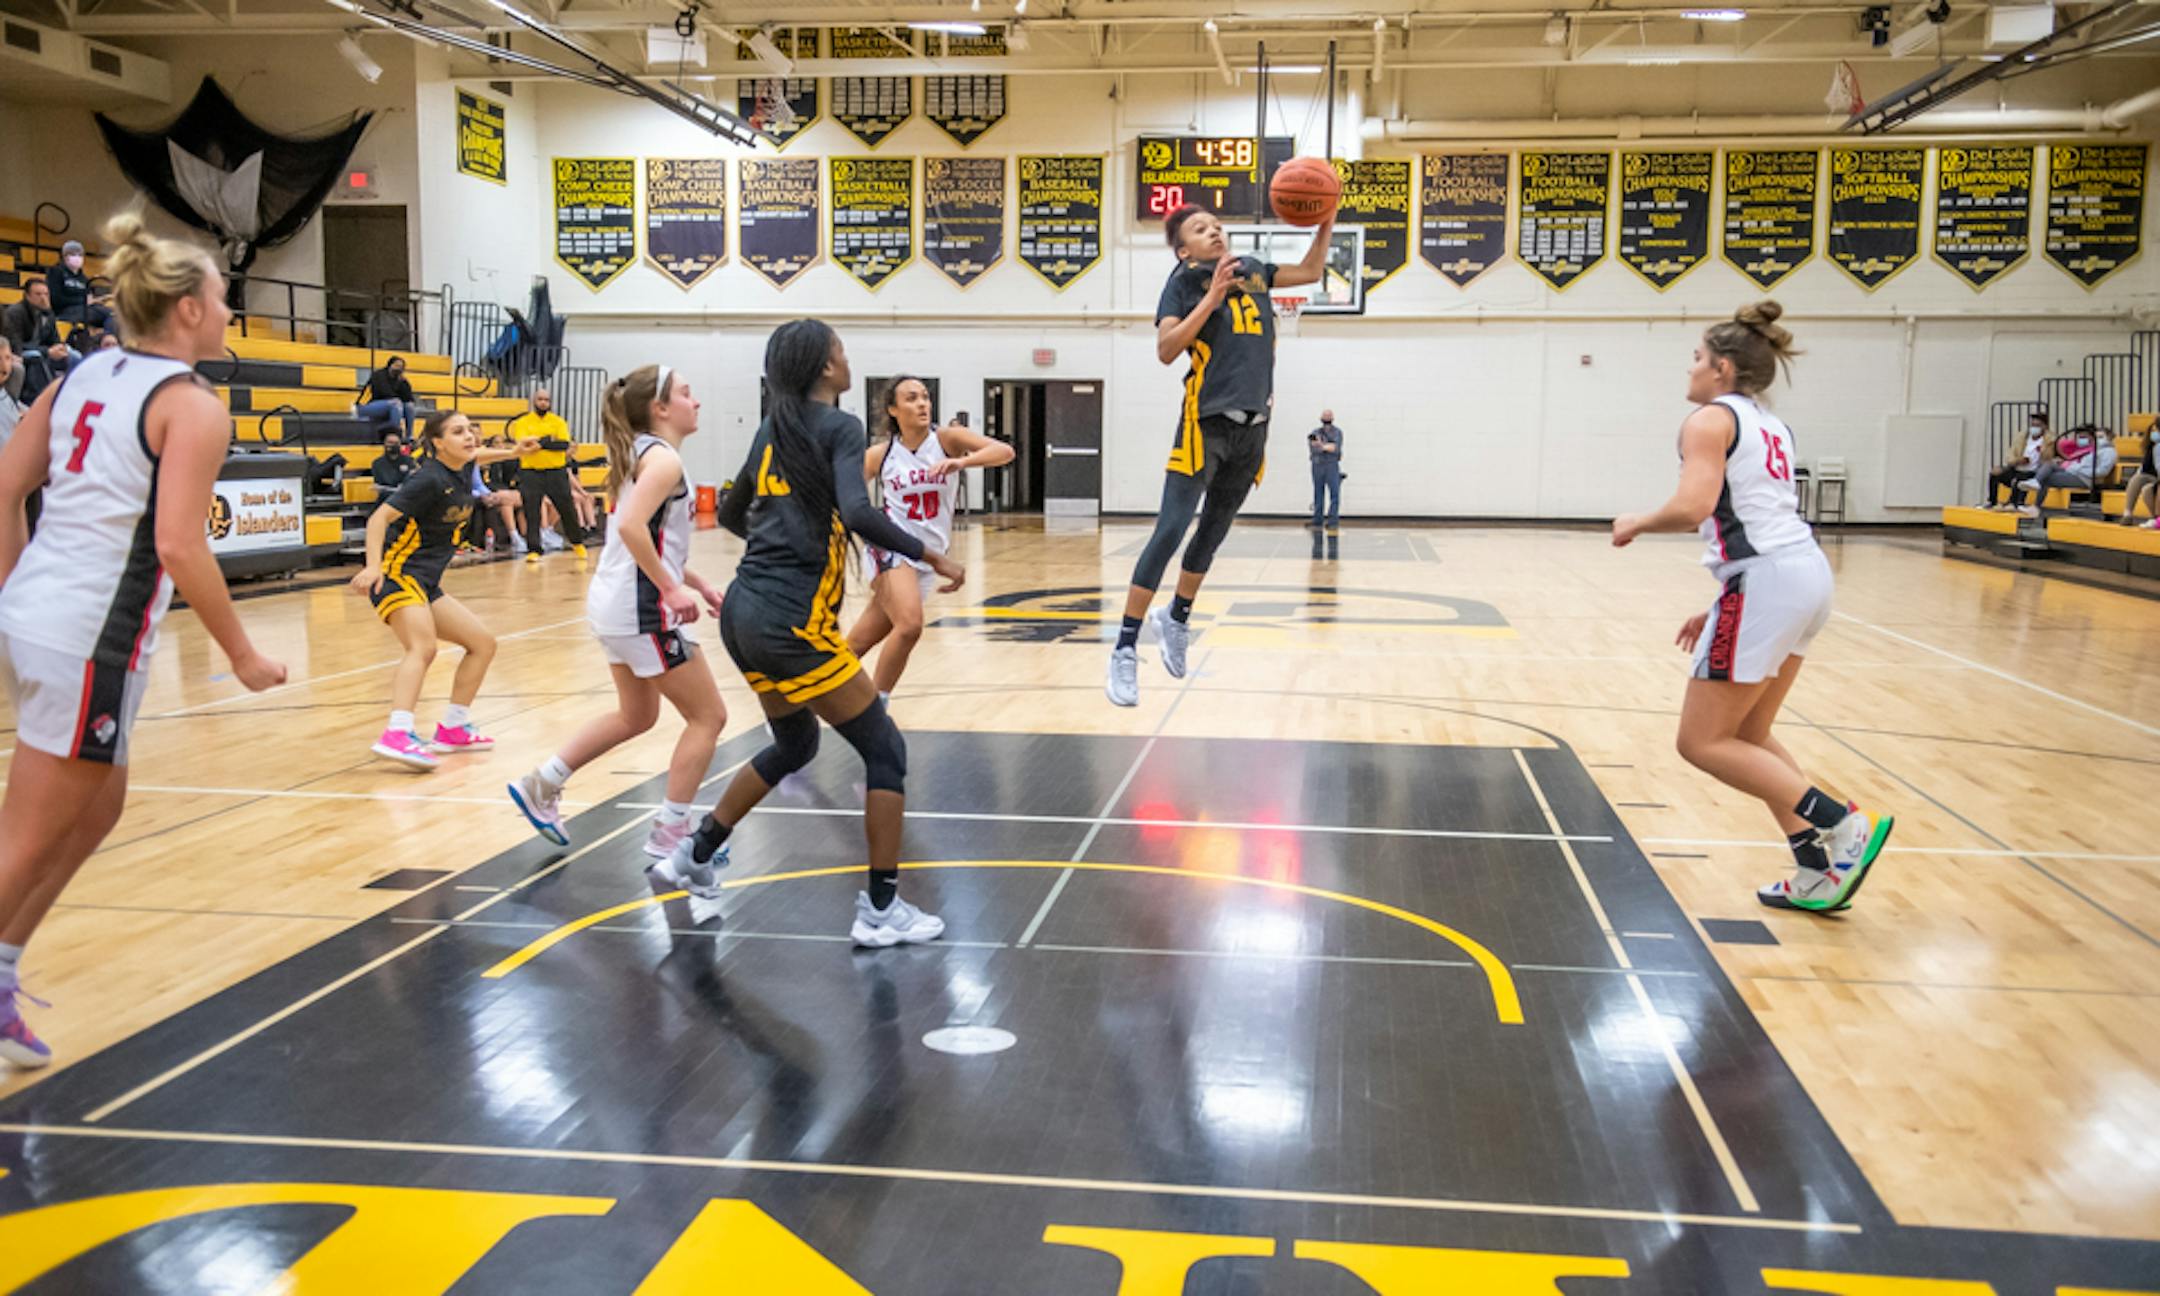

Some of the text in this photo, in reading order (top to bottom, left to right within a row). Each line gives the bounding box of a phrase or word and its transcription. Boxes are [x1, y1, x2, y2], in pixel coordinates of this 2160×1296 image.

[1196, 140, 1252, 166] 4:58
[744, 180, 812, 190] BASKETBALL
[834, 181, 907, 191] BASKETBALL
[958, 179, 1002, 190] SOCCER
[1030, 179, 1091, 190] BASEBALL
[1142, 172, 1200, 184] ISLANDERS
[1432, 177, 1496, 188] FOOTBALL
[1531, 176, 1596, 187] FOOTBALL
[1624, 175, 1708, 193] CHAMPIONSHIPS
[1728, 174, 1814, 192] CHAMPIONSHIPS
[1843, 172, 1910, 183] SOFTBALL
[1941, 171, 2029, 190] CHAMPIONSHIPS
[2052, 169, 2142, 188] CHAMPIONSHIPS
[1362, 184, 1407, 194] SOCCER
[1424, 188, 1505, 205] CHAMPIONSHIPS
[1523, 187, 1605, 205] CHAMPIONSHIPS
[1834, 183, 1919, 202] CHAMPIONSHIPS
[648, 191, 725, 208] CHAMPIONSHIPS
[741, 191, 817, 208] CHAMPIONSHIPS
[834, 192, 910, 208] CHAMPIONSHIPS
[926, 190, 1002, 208] CHAMPIONSHIPS
[1022, 190, 1099, 207] CHAMPIONSHIPS
[1150, 186, 1184, 212] 20
[1215, 189, 1223, 208] 1
[1228, 294, 1263, 335] 12
[66, 400, 105, 474] 5
[902, 491, 939, 521] 20
[236, 510, 299, 536] Islanders
